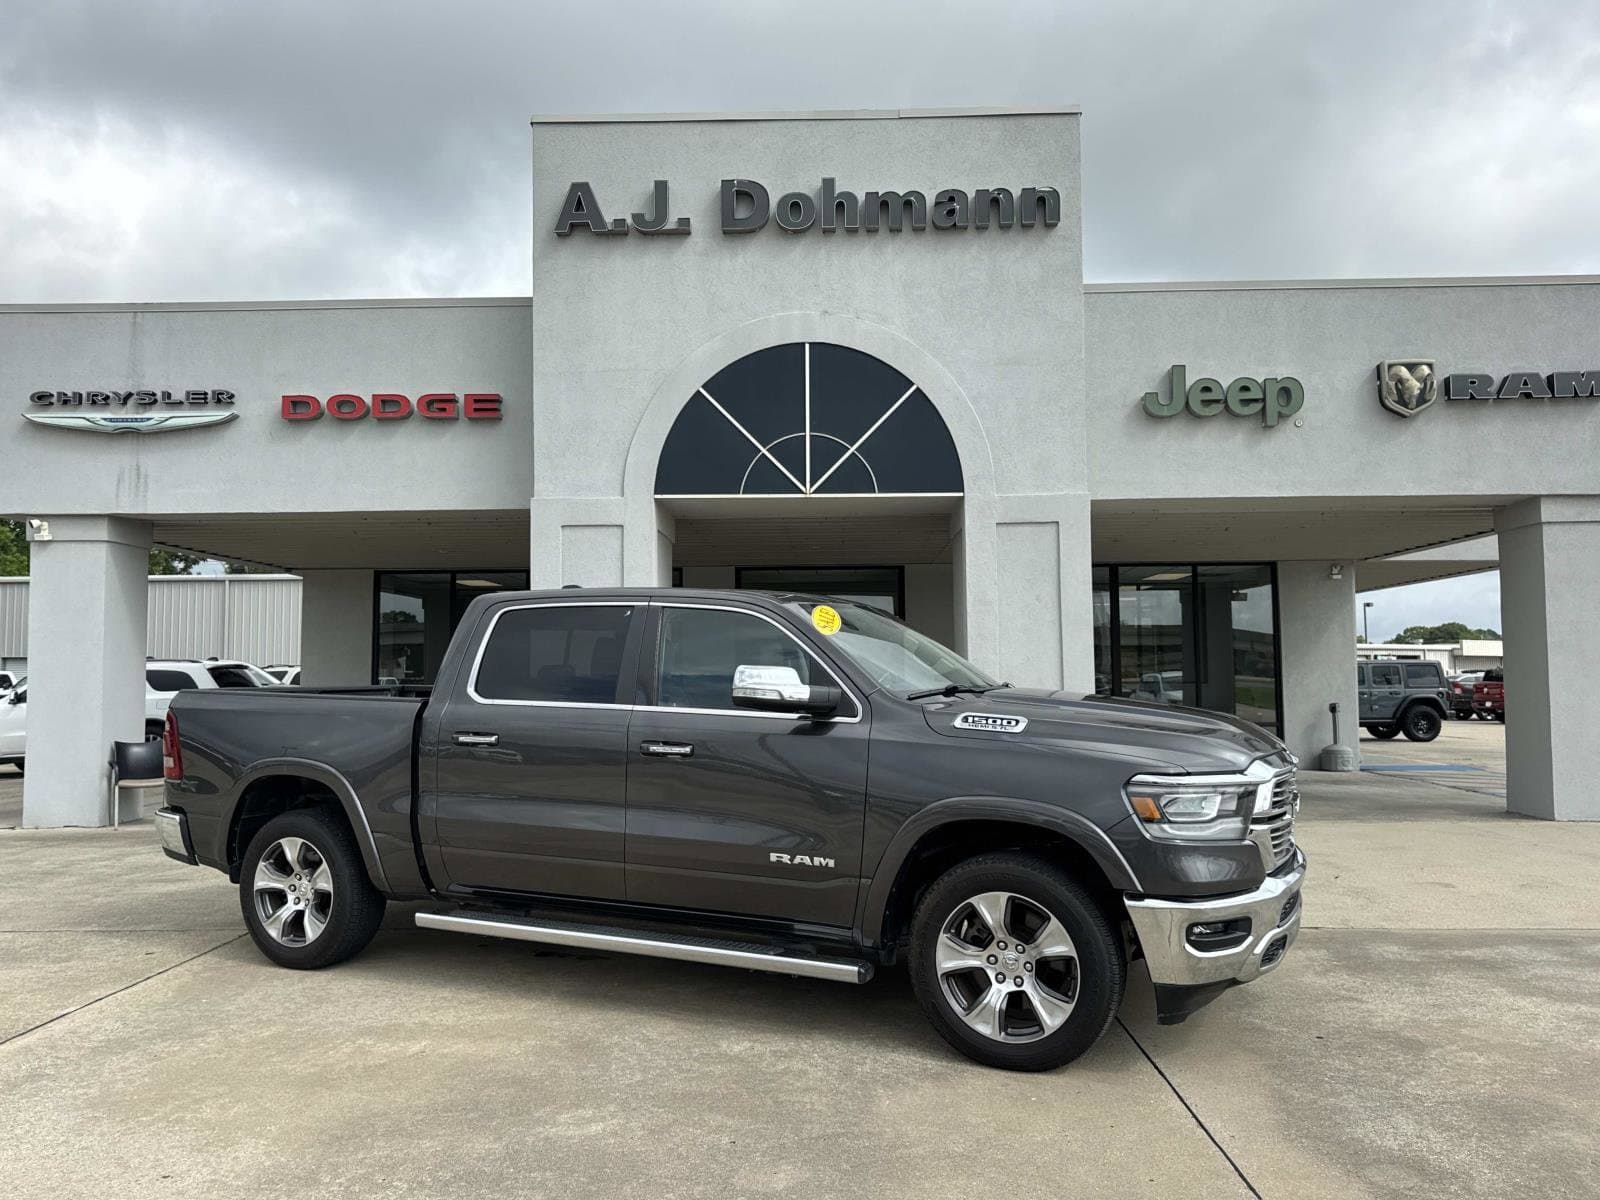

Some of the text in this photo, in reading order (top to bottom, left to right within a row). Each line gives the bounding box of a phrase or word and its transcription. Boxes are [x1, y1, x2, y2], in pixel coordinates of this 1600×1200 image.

[553, 177, 1061, 235] A.J. Dohmann
[29, 390, 236, 406] CHRYSLER
[1142, 364, 1304, 427] Jeep
[1444, 371, 1600, 400] RAM
[281, 393, 503, 420] DODGE
[965, 716, 1018, 726] 1500
[769, 852, 835, 868] RAM
